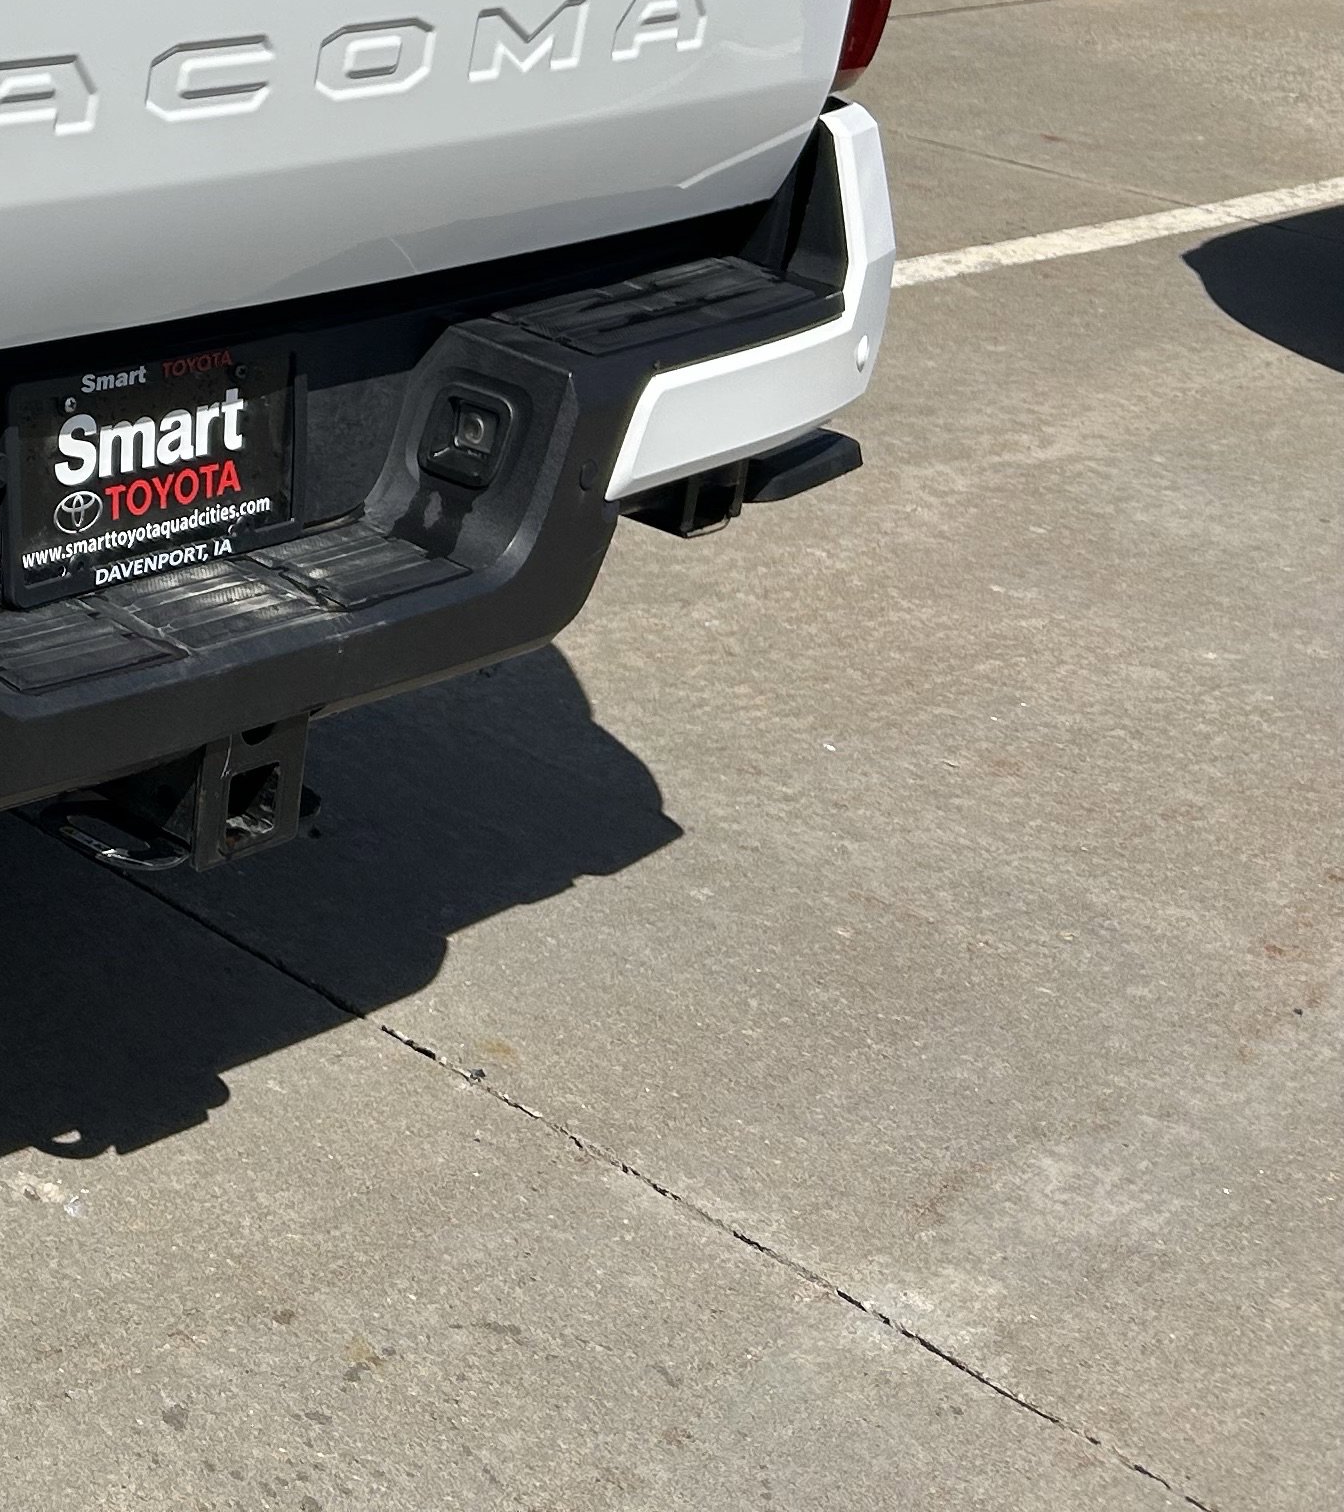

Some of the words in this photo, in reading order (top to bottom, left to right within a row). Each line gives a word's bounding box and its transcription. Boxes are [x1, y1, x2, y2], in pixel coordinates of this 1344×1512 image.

[81, 365, 147, 394] Smart
[161, 349, 233, 379] TOYOTA
[54, 387, 244, 487] Smart
[105, 459, 242, 521] TOYOTA
[22, 495, 271, 570] www.smarttoyotaquadcities.com
[95, 543, 209, 586] DAVENPORT,
[213, 537, 233, 556] IA
